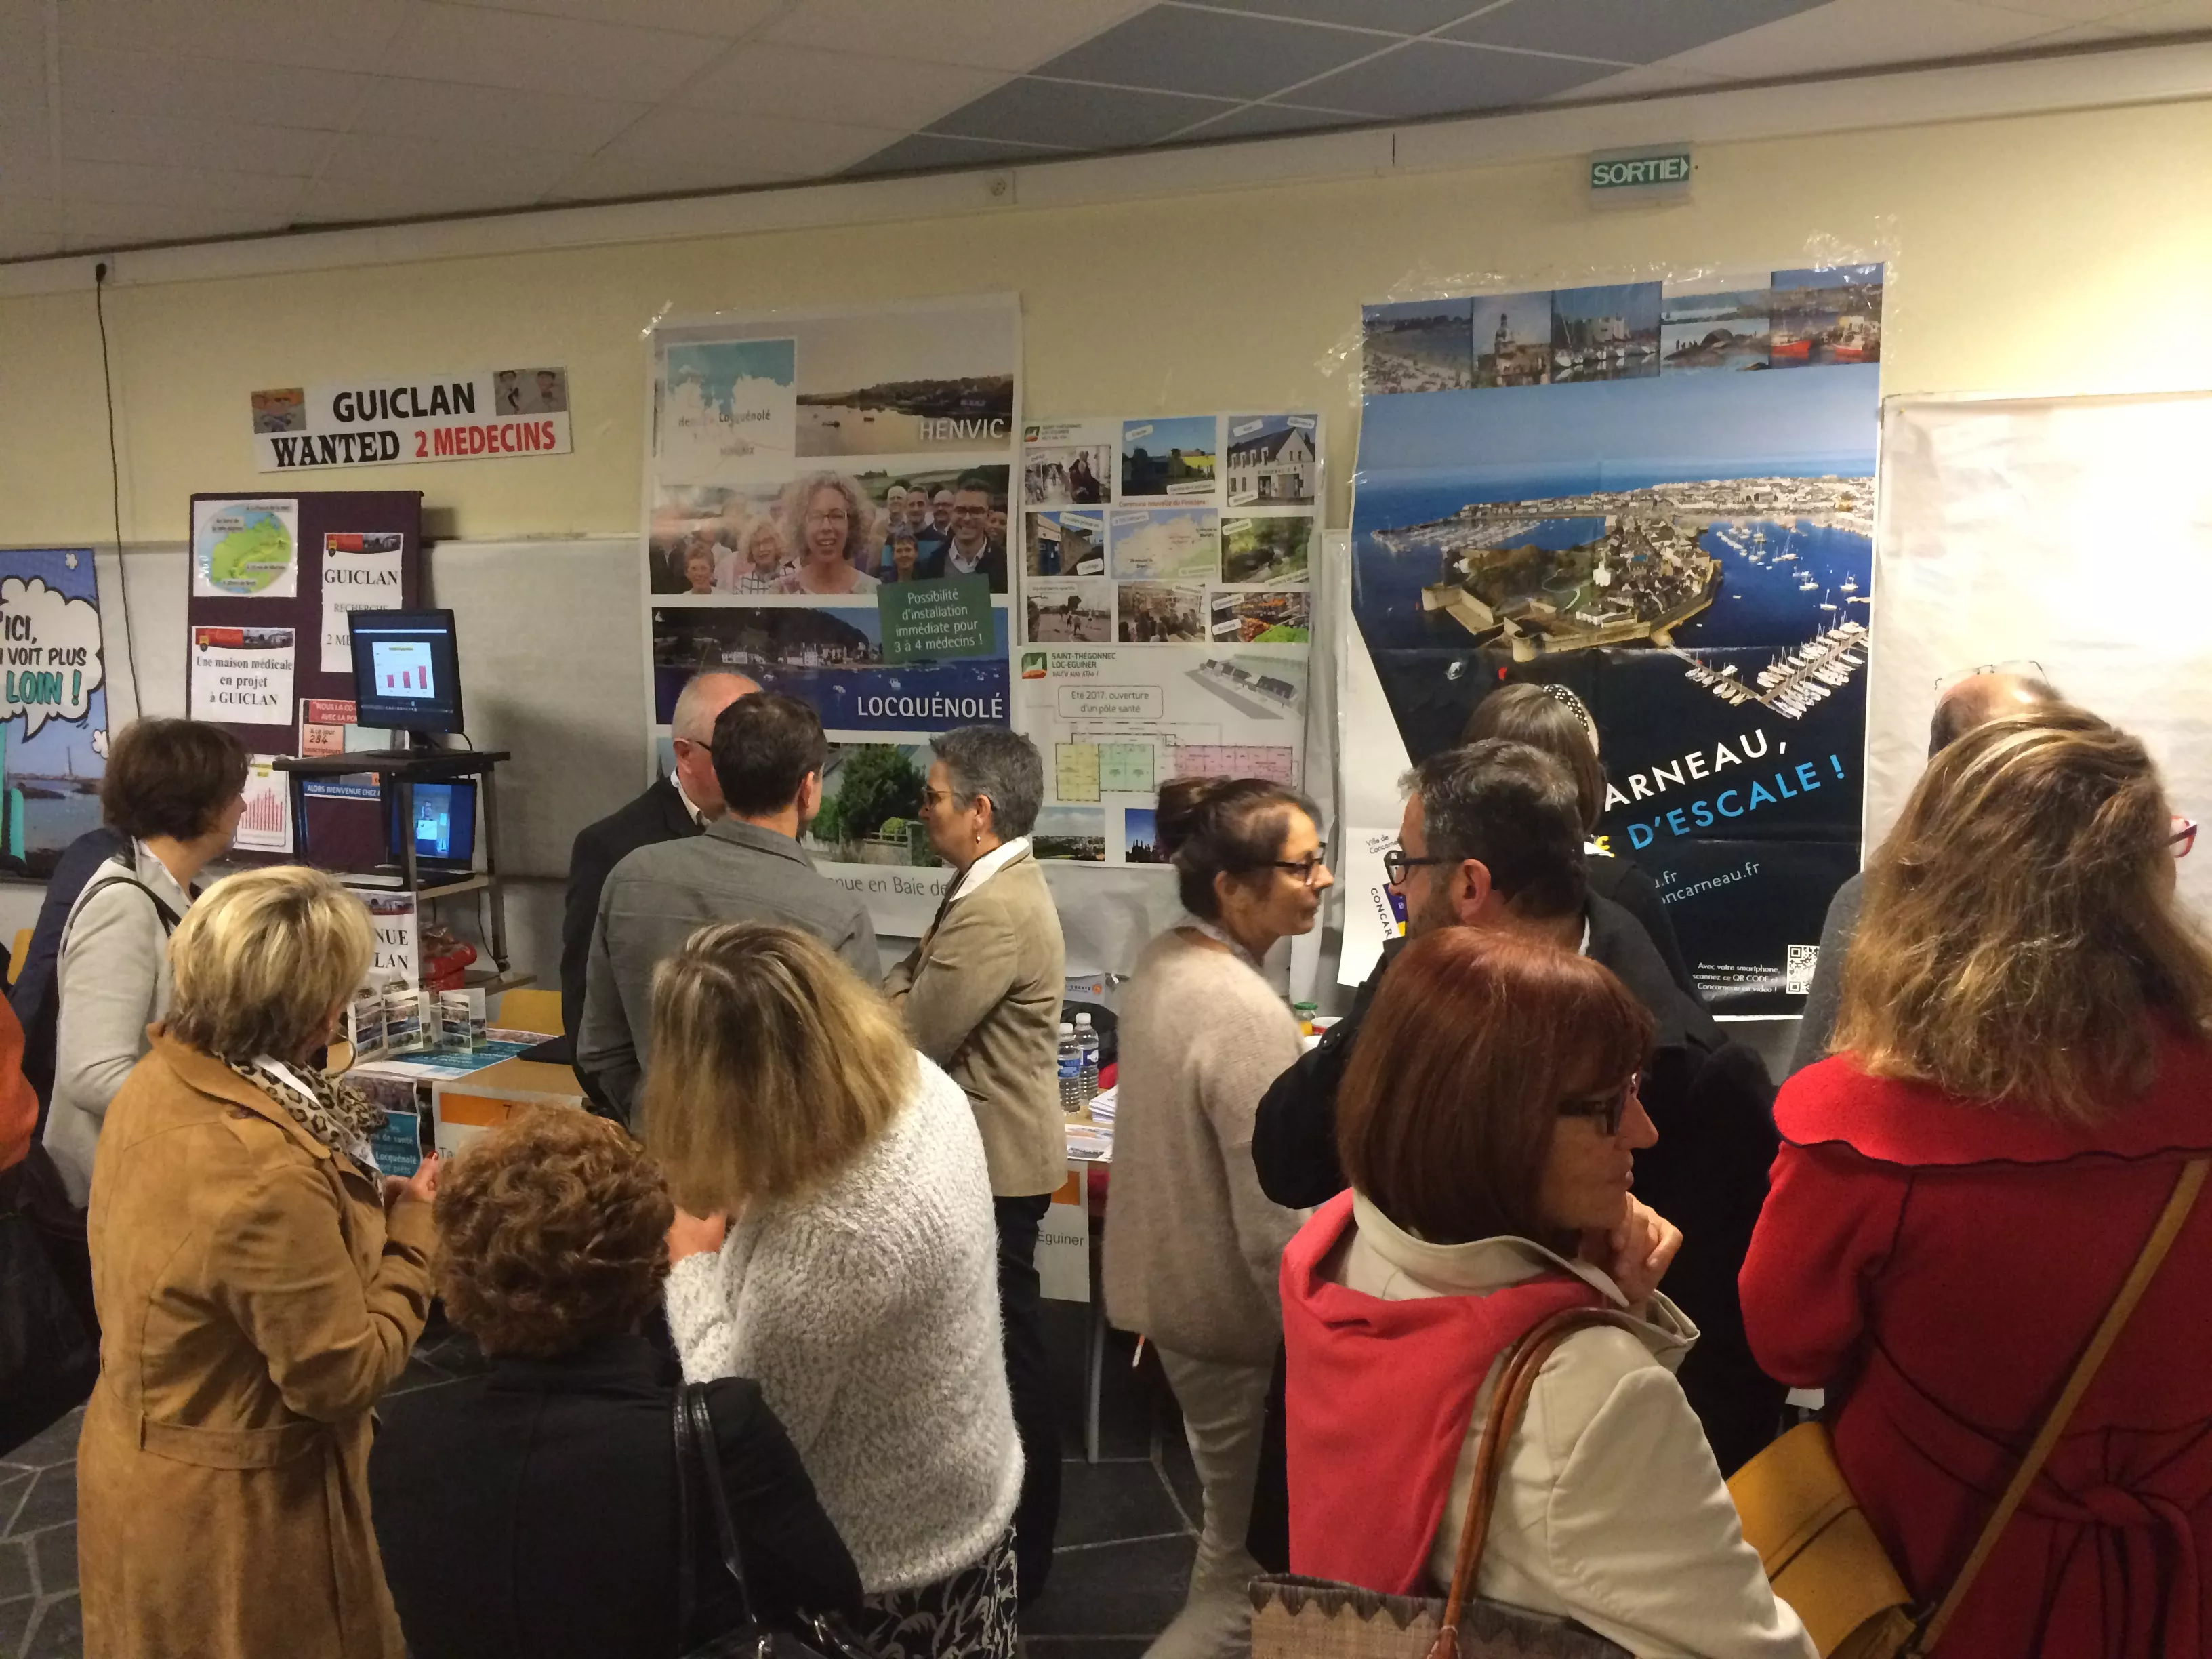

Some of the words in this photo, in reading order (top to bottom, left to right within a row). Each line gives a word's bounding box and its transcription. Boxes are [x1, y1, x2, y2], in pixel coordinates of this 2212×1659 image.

[1593, 158, 1679, 185] SORTIE
[333, 382, 476, 422] GUICLAN
[920, 418, 1004, 441] HENVIC
[271, 430, 400, 467] WANTED
[415, 430, 428, 457] 2
[434, 420, 556, 457] MEDECINS
[324, 569, 398, 586] GUICLAN
[907, 588, 959, 604] Possibilité
[902, 605, 968, 621] d'installation
[896, 622, 950, 637] immédiate
[954, 621, 978, 634] pour
[327, 634, 332, 645] 2
[894, 641, 901, 653] 3
[905, 640, 911, 651] à
[915, 639, 922, 651] 4
[926, 635, 975, 650] médecins
[7, 647, 43, 665] VOIT
[49, 647, 87, 666] PLUS
[197, 656, 212, 667] Une
[215, 657, 249, 668] maison
[251, 658, 293, 670] médicale
[1052, 651, 1117, 660] SAINT-THÉGONNEC
[6, 670, 64, 705] LOIN
[71, 669, 82, 706] !
[220, 676, 232, 686] en
[236, 676, 268, 690] projet
[209, 691, 216, 703] à
[219, 692, 279, 705] GUICLAN
[1109, 692, 1149, 700] ouverture
[857, 691, 1004, 718] LOCQUÉNOLÉ
[1099, 704, 1117, 714] pôle
[1118, 705, 1141, 713] santé
[309, 735, 328, 745] 284
[327, 786, 361, 795] BIENVENUE
[362, 788, 377, 796] CHEZ
[1626, 761, 1821, 851] D'ESCALE
[1829, 754, 1845, 780] !
[869, 879, 887, 893] en
[893, 876, 925, 895] Baie
[1698, 962, 1716, 970] Avec
